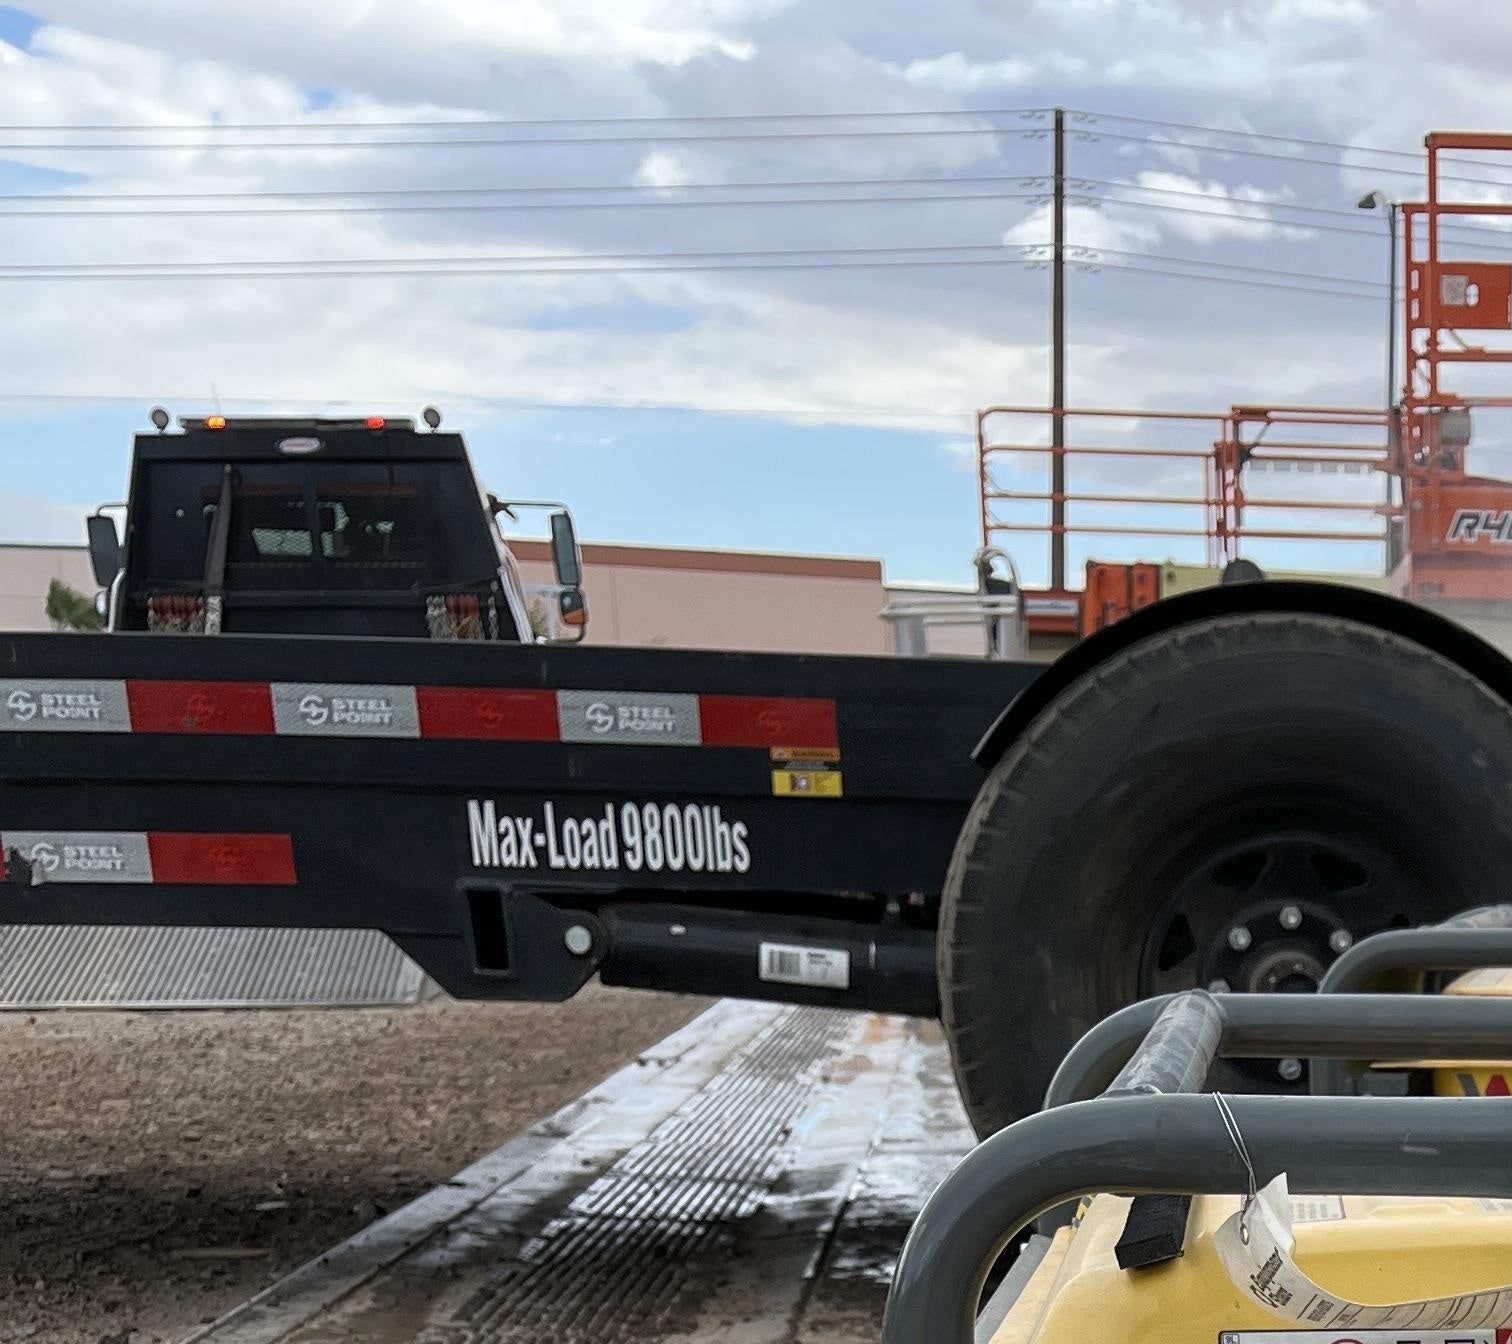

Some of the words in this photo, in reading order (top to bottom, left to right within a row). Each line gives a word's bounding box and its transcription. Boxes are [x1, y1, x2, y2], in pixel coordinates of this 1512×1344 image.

[41, 694, 101, 705] STEEL
[331, 699, 393, 711] STEEL
[618, 706, 675, 719] STEEL
[618, 718, 676, 732] POINT
[467, 799, 619, 869] Max-Load
[621, 801, 751, 873] 9800lbs
